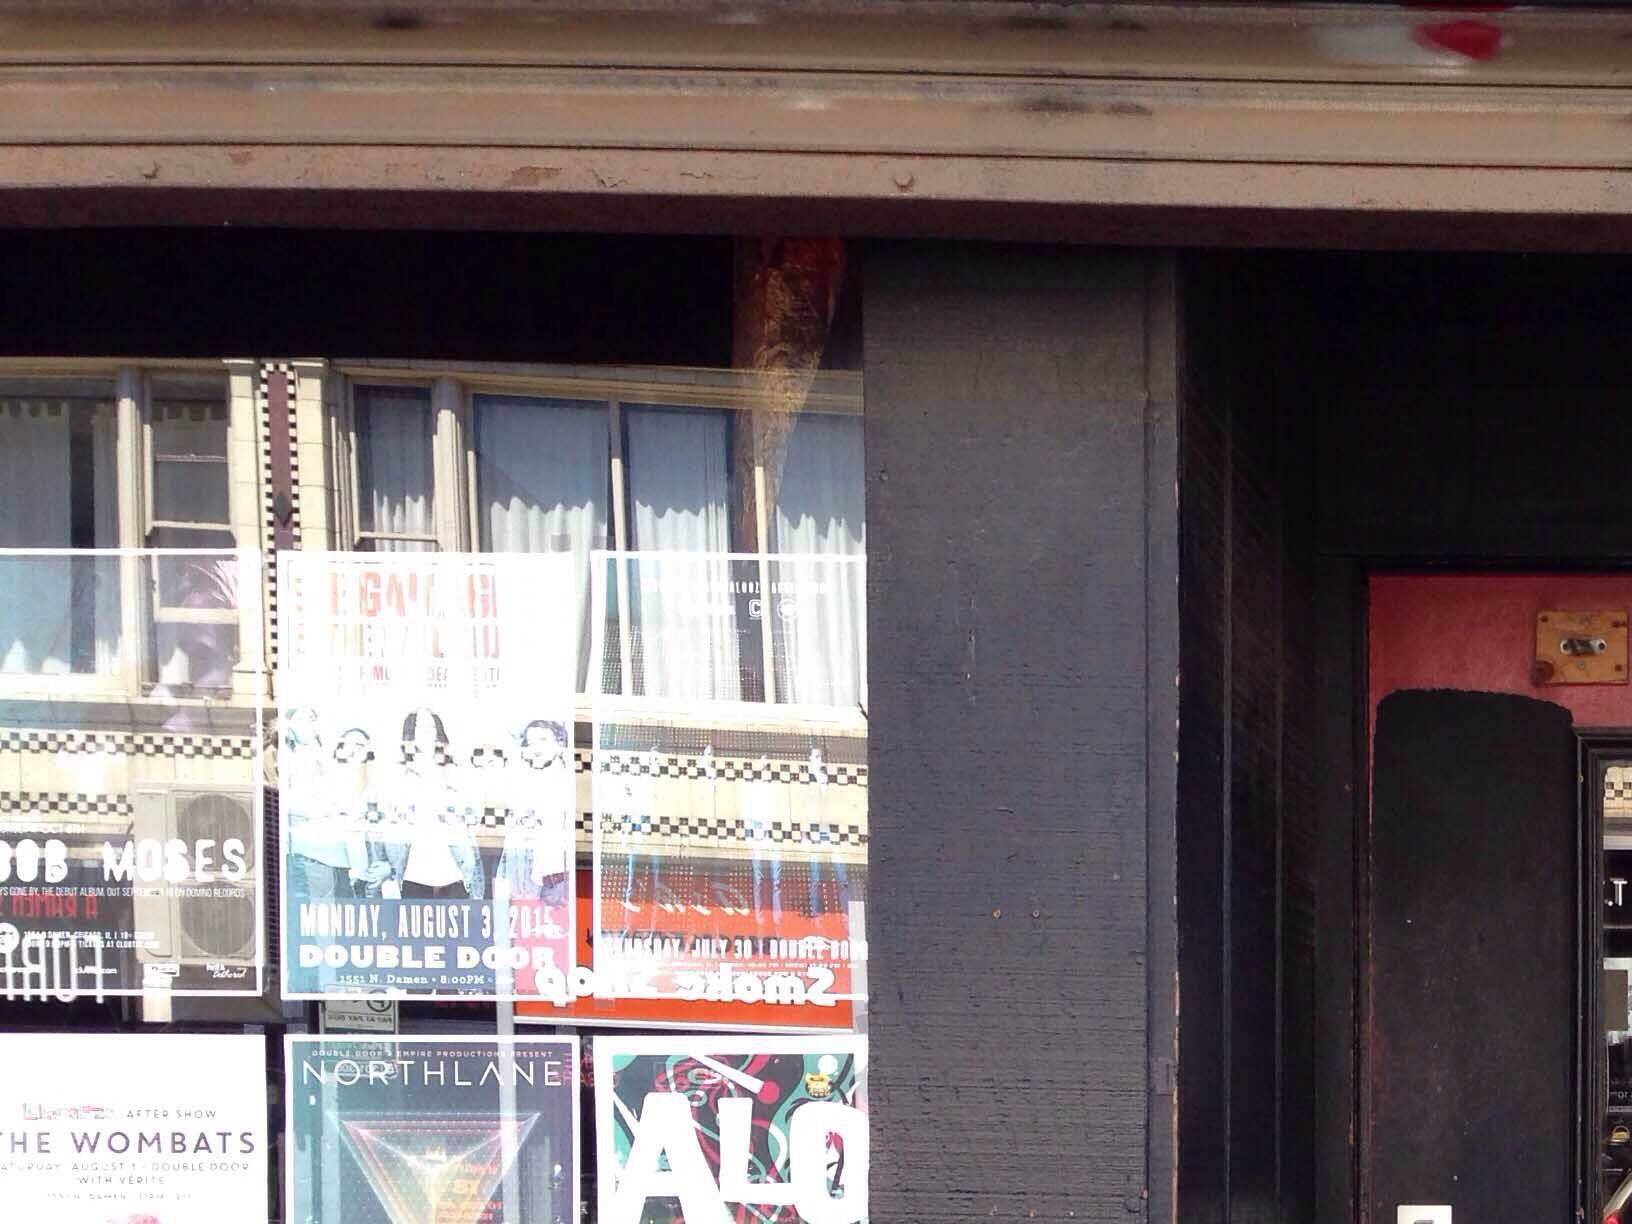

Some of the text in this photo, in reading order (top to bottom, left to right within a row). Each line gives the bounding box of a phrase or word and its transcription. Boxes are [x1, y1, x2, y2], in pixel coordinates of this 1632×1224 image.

[103, 838, 246, 882] MOSES
[41, 887, 53, 896] THE
[55, 887, 77, 896] DEBUT
[106, 887, 120, 896] OUT
[301, 903, 387, 940] MONDAY,
[398, 904, 470, 939] AUGUST
[299, 945, 555, 969] DOUBLE DOOR
[691, 937, 727, 959] JULY
[735, 938, 752, 959] 30
[387, 974, 428, 985] Damen
[440, 974, 485, 985] 8:00PM
[303, 1060, 561, 1086] NORTHLANE
[127, 1109, 217, 1119] AFTER SHOW
[0, 1132, 255, 1154] HE WOMBATS
[151, 1162, 205, 1172] DOUBLE
[209, 1162, 249, 1172] DOOR
[79, 1175, 113, 1185] WITH
